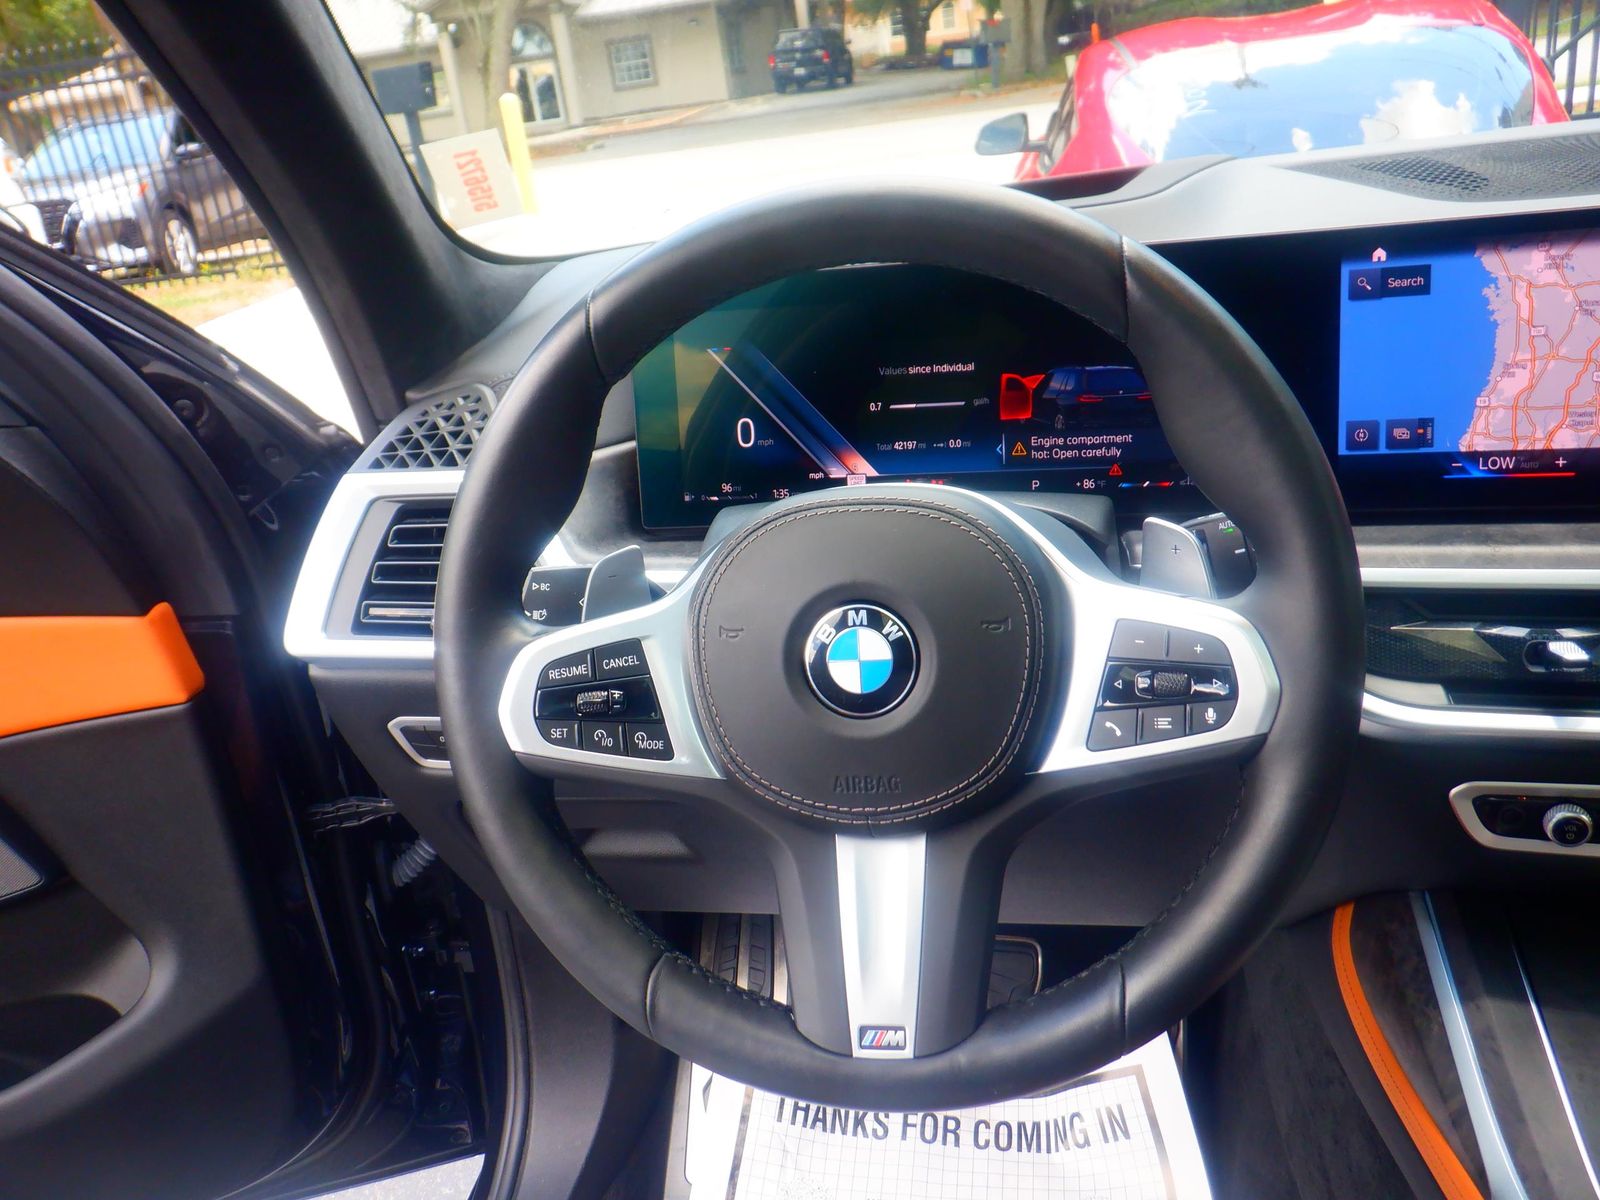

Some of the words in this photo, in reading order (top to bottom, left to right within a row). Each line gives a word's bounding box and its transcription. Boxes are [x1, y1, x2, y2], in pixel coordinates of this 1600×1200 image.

[1387, 276, 1424, 288] Search
[879, 367, 907, 375] Values
[908, 365, 931, 374] since
[933, 362, 975, 372] Individual
[869, 402, 882, 411] 0.7
[736, 417, 755, 448] 0
[757, 438, 775, 447] mph
[877, 443, 892, 451] Total
[893, 441, 917, 450] 42197
[948, 439, 962, 448] 0.0
[1031, 437, 1064, 447] Engine
[1066, 434, 1133, 445] compartment
[1031, 451, 1050, 459] hot:
[1052, 449, 1079, 459] Open
[1081, 448, 1122, 458] carefully
[1479, 457, 1515, 470] LOW
[809, 472, 825, 480] mph
[721, 483, 733, 493] 96
[1032, 480, 1040, 490] P
[773, 488, 790, 499] 1:35
[540, 583, 551, 591] BC
[816, 609, 904, 645] BMW
[602, 655, 639, 670] CANCEL
[549, 664, 589, 681] RESUME
[550, 728, 568, 739] SET
[638, 740, 665, 750] MODE
[833, 776, 902, 794] AIRBAG
[901, 1112, 962, 1148] FOR
[973, 1111, 1091, 1154] COMING
[1096, 1103, 1131, 1144] IN
